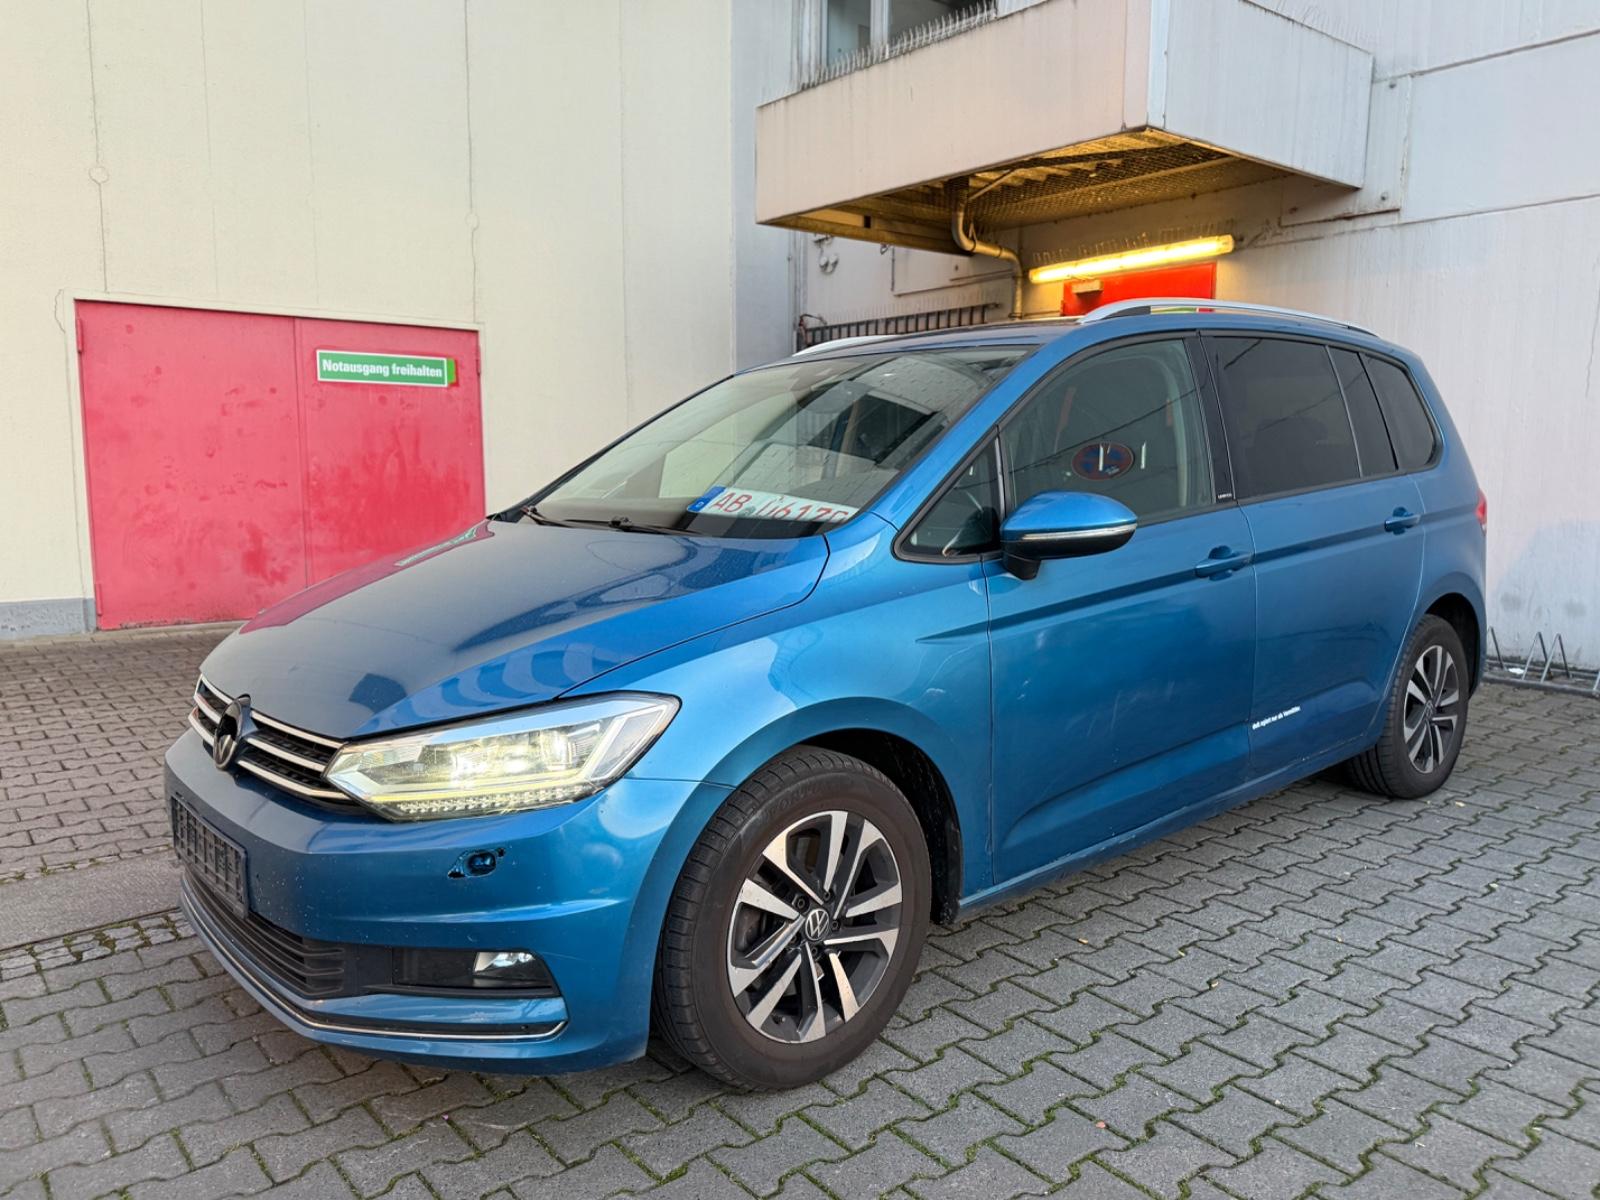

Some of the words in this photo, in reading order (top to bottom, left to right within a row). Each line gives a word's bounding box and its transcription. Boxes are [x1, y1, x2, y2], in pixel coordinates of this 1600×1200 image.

[321, 359, 390, 377] Notausgang
[390, 363, 443, 378] freihalten
[710, 492, 753, 513] AB
